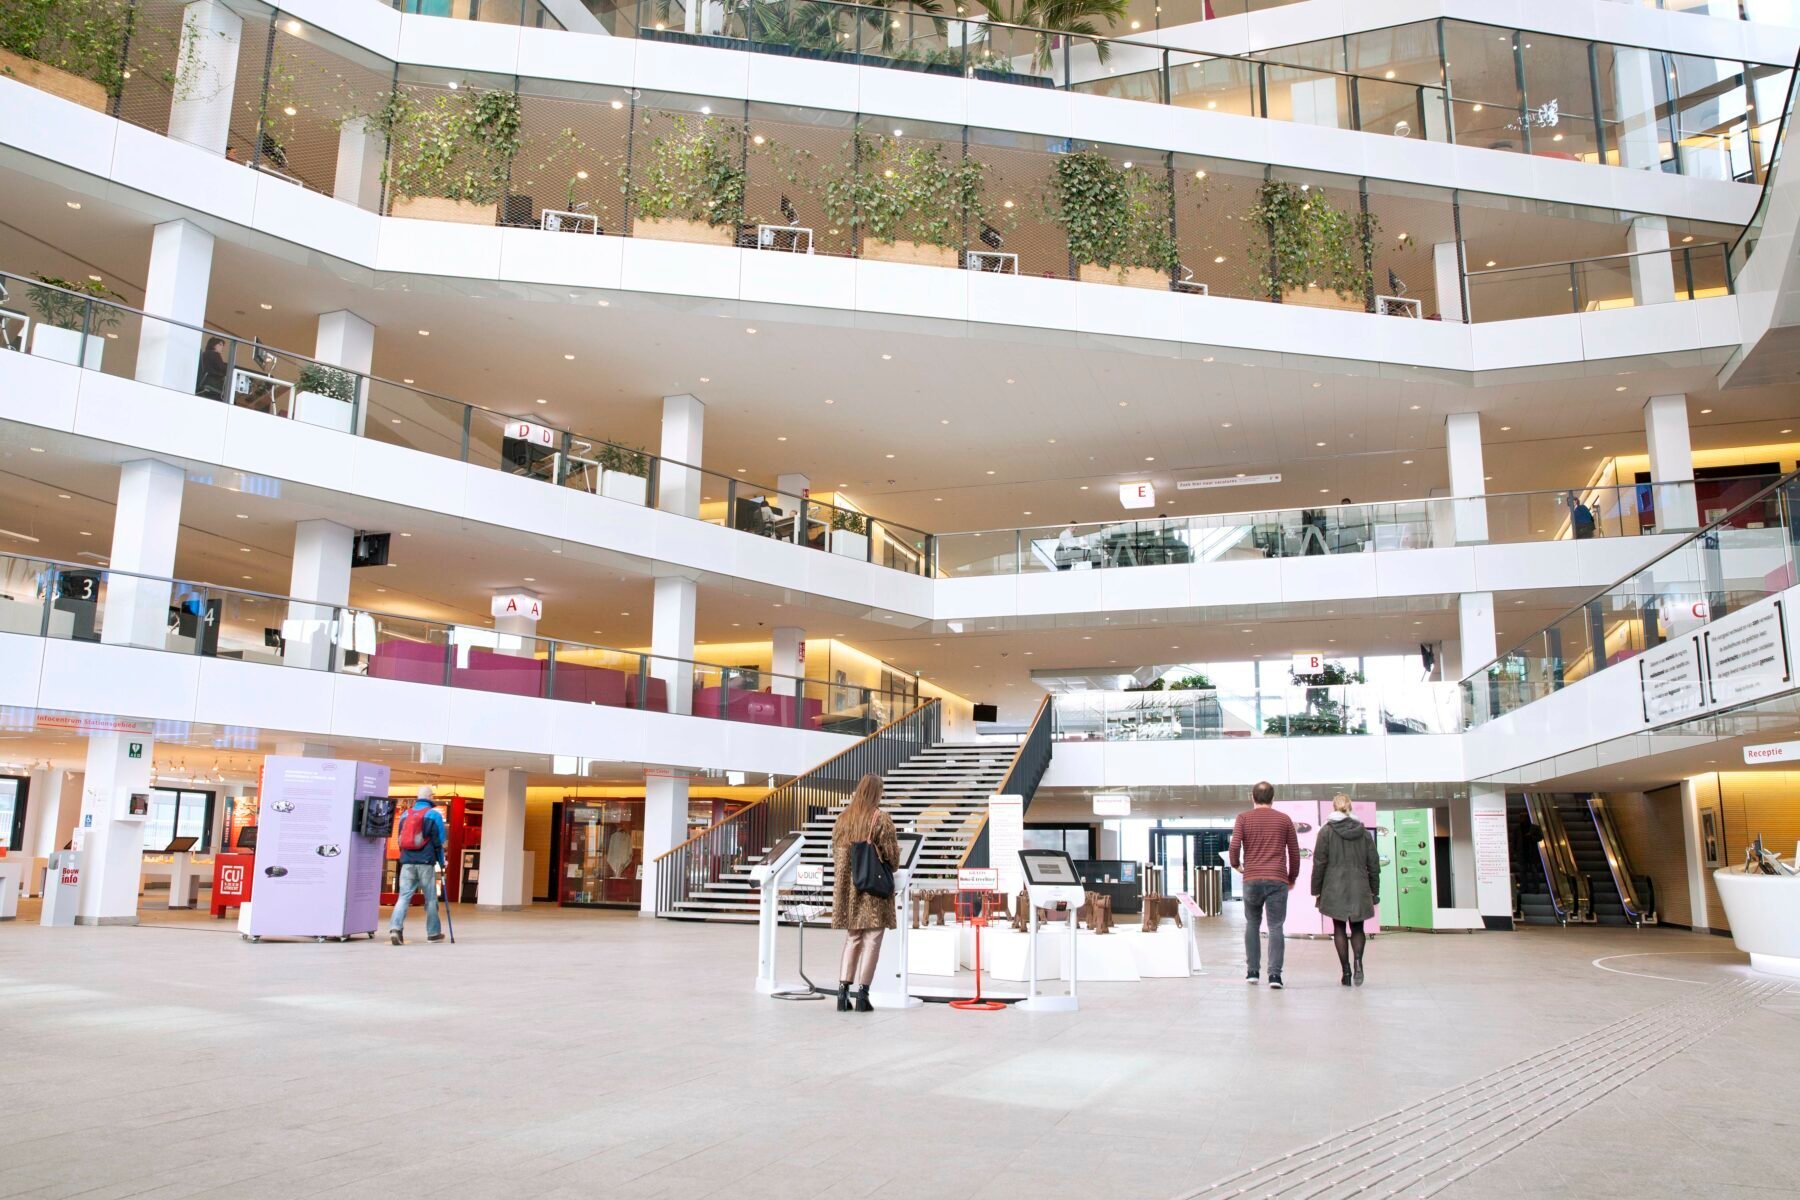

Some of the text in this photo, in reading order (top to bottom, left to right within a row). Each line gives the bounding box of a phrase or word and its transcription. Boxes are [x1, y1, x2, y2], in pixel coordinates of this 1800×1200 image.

[520, 424, 530, 437] D
[543, 429, 550, 443] D
[1138, 485, 1146, 497] E
[81, 578, 93, 600] 3
[506, 598, 517, 612] A
[531, 602, 539, 617] A
[1692, 603, 1707, 618] C
[204, 607, 215, 627] 4
[1310, 656, 1319, 668] B
[37, 714, 136, 729] Infocentrum Stationsgebied
[1748, 748, 1783, 758] Receptie
[62, 867, 79, 875] Bouw
[224, 869, 240, 883] CU
[61, 874, 78, 884] info
